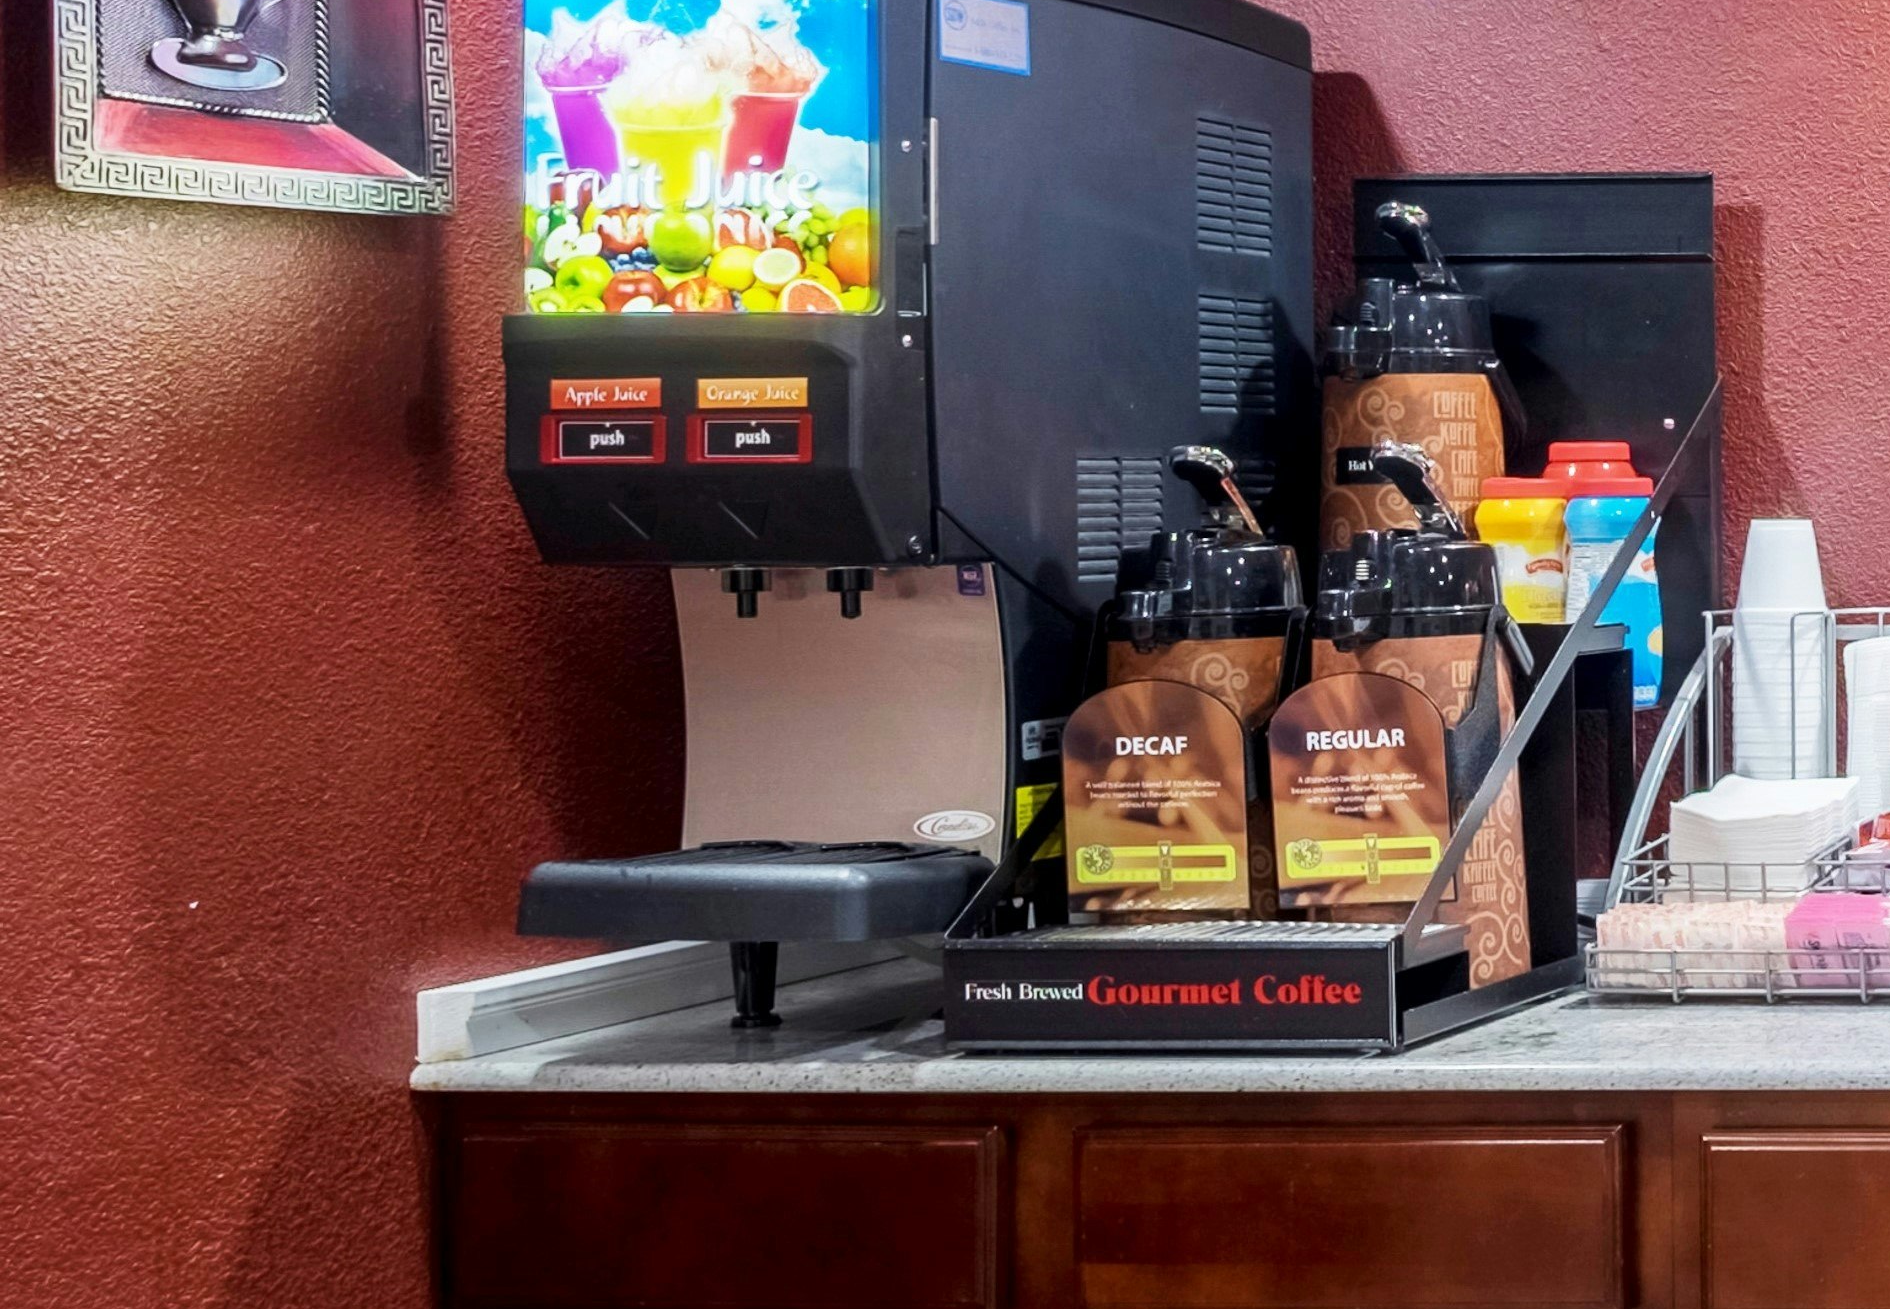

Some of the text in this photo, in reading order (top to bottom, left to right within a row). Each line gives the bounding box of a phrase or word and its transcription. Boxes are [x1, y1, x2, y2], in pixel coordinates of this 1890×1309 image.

[535, 151, 821, 209] Fruit Juice
[564, 385, 649, 406] Apple Juice
[705, 384, 799, 406] Orange Juice
[589, 429, 625, 449] push
[735, 428, 771, 448] push
[1348, 460, 1367, 471] Hot
[1115, 736, 1188, 756] DECAF
[1306, 728, 1405, 752] REGULAR
[965, 974, 1362, 1005] Fresh Brewed Gourmet Coffee
